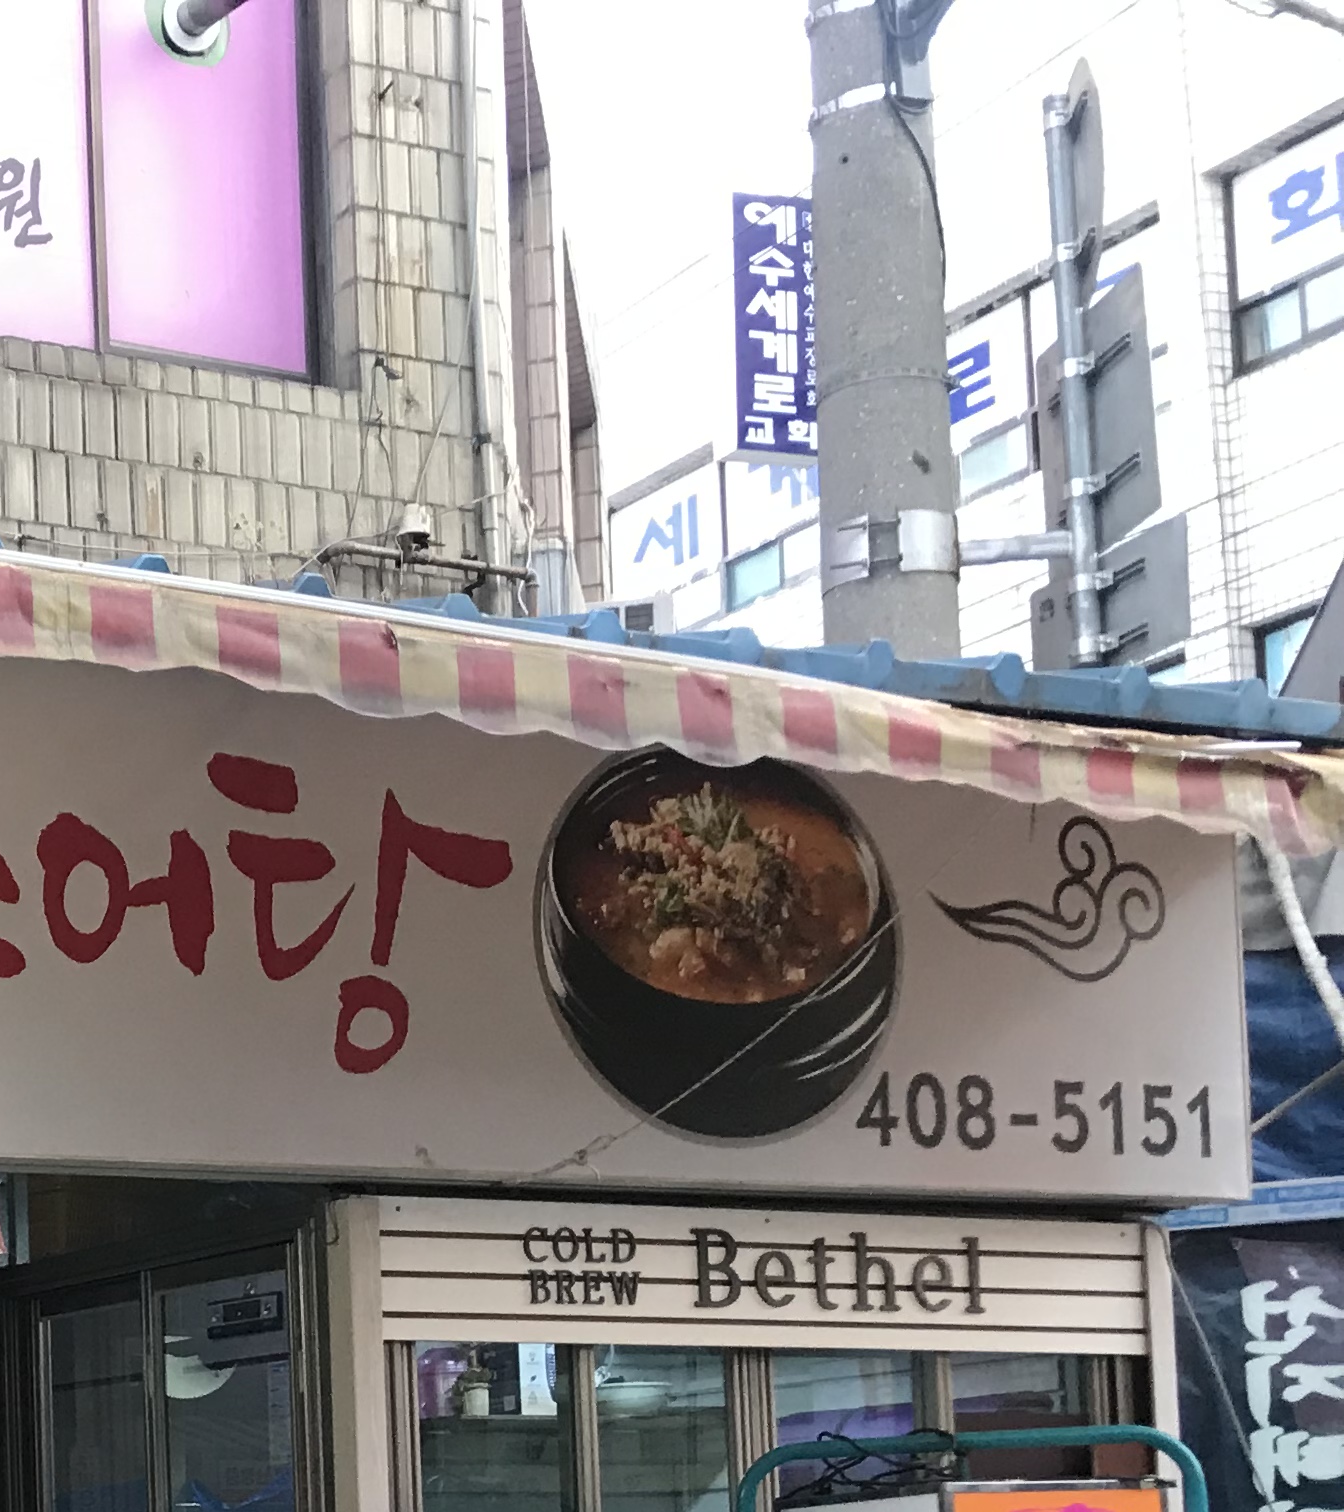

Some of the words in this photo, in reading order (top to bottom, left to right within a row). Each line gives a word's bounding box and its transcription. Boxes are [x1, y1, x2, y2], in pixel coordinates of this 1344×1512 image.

[855, 1071, 1214, 1159] 408-5151
[523, 1226, 637, 1264] COLD
[690, 1228, 987, 1315] Bethel
[529, 1271, 641, 1307] BREW
